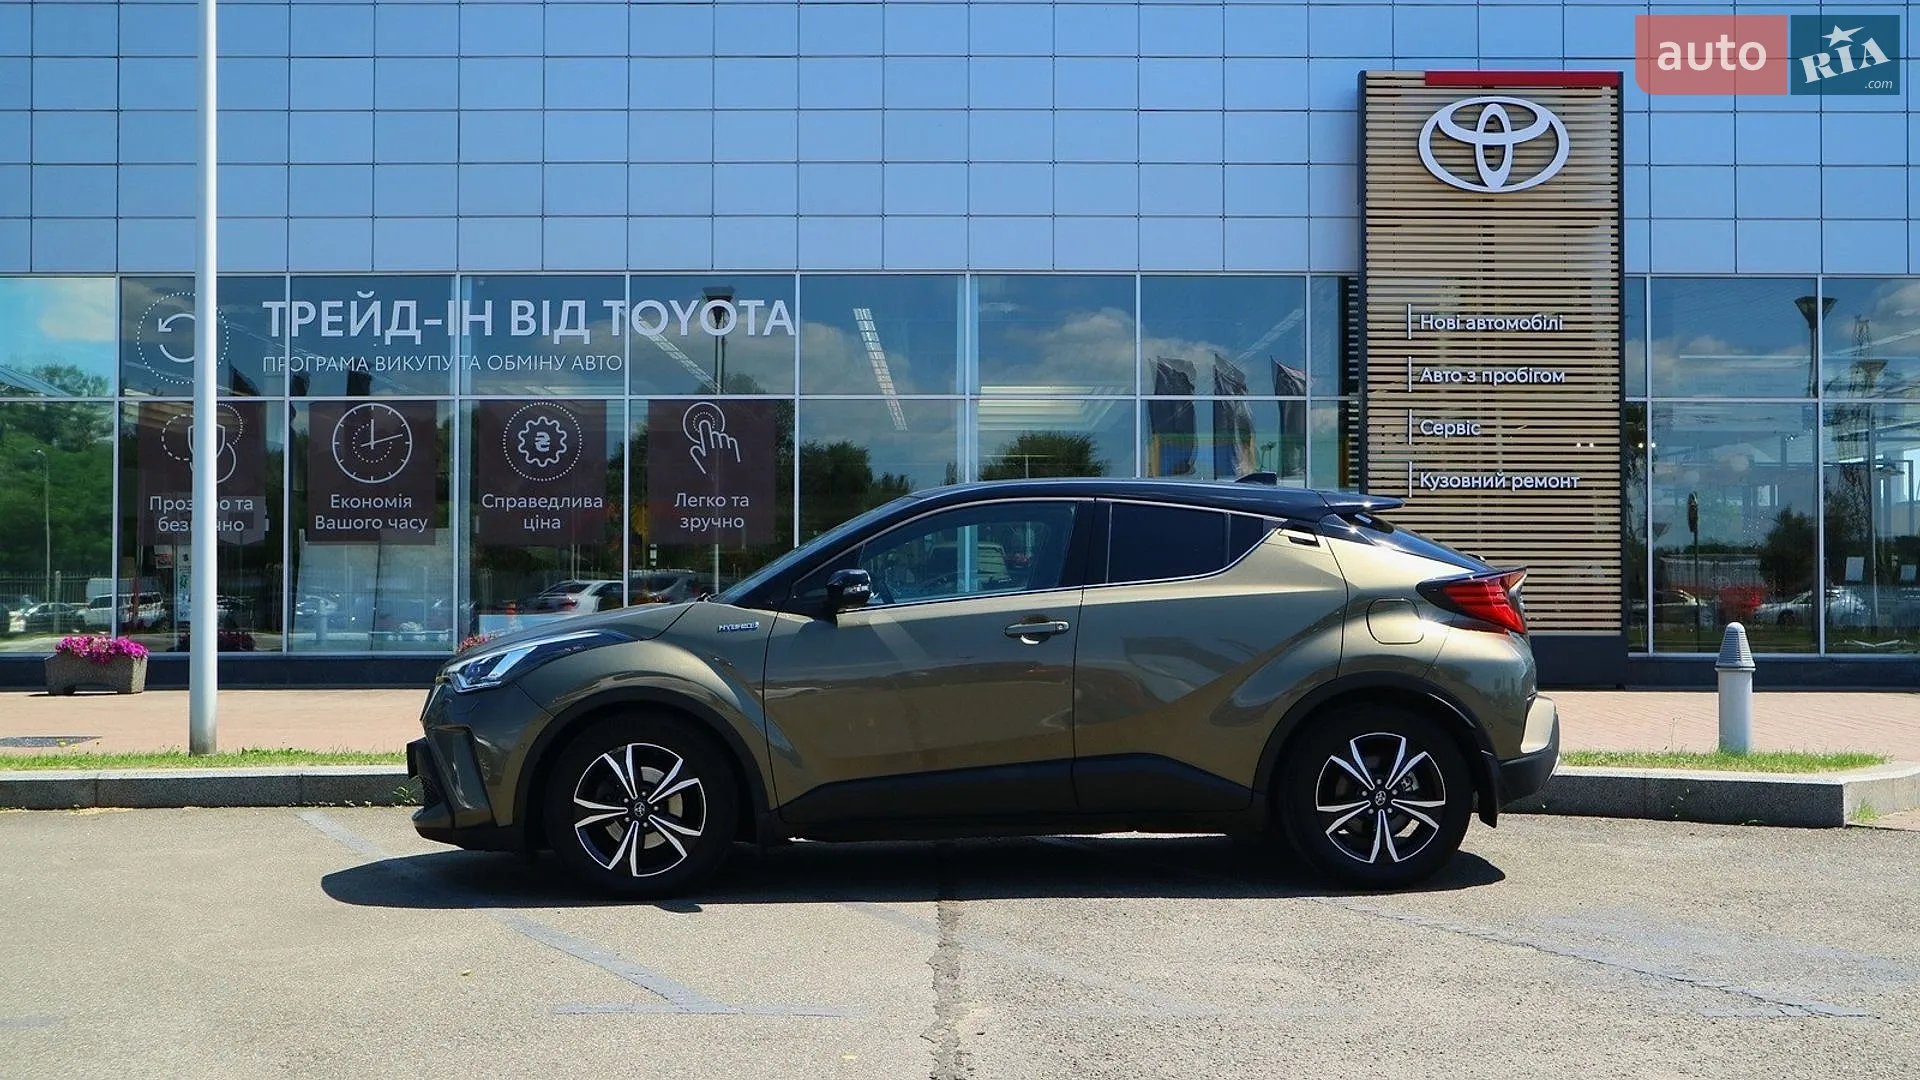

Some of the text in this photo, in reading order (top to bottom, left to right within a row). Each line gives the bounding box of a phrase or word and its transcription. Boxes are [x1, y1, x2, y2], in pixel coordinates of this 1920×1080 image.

[262, 290, 796, 346] ТРЕЙД-ІН ВІД TOYOTA
[1420, 314, 1563, 331] Нові автомобілі
[263, 354, 622, 372] ПРОГРАМА ВИКУПУ ТА ОБМІНУ АВТО
[1420, 367, 1566, 387] Авто з пробігом
[1420, 419, 1481, 439] Сервіс
[1420, 472, 1580, 492] Кузовний ремонт
[150, 496, 253, 513] Прозо та
[330, 493, 412, 509] Економія
[481, 493, 603, 513] Справедлива
[674, 493, 749, 507] Легко та
[158, 516, 245, 532] безно
[315, 514, 428, 532] Вашого часу
[524, 514, 561, 530] ціна
[680, 517, 744, 532] зручно
